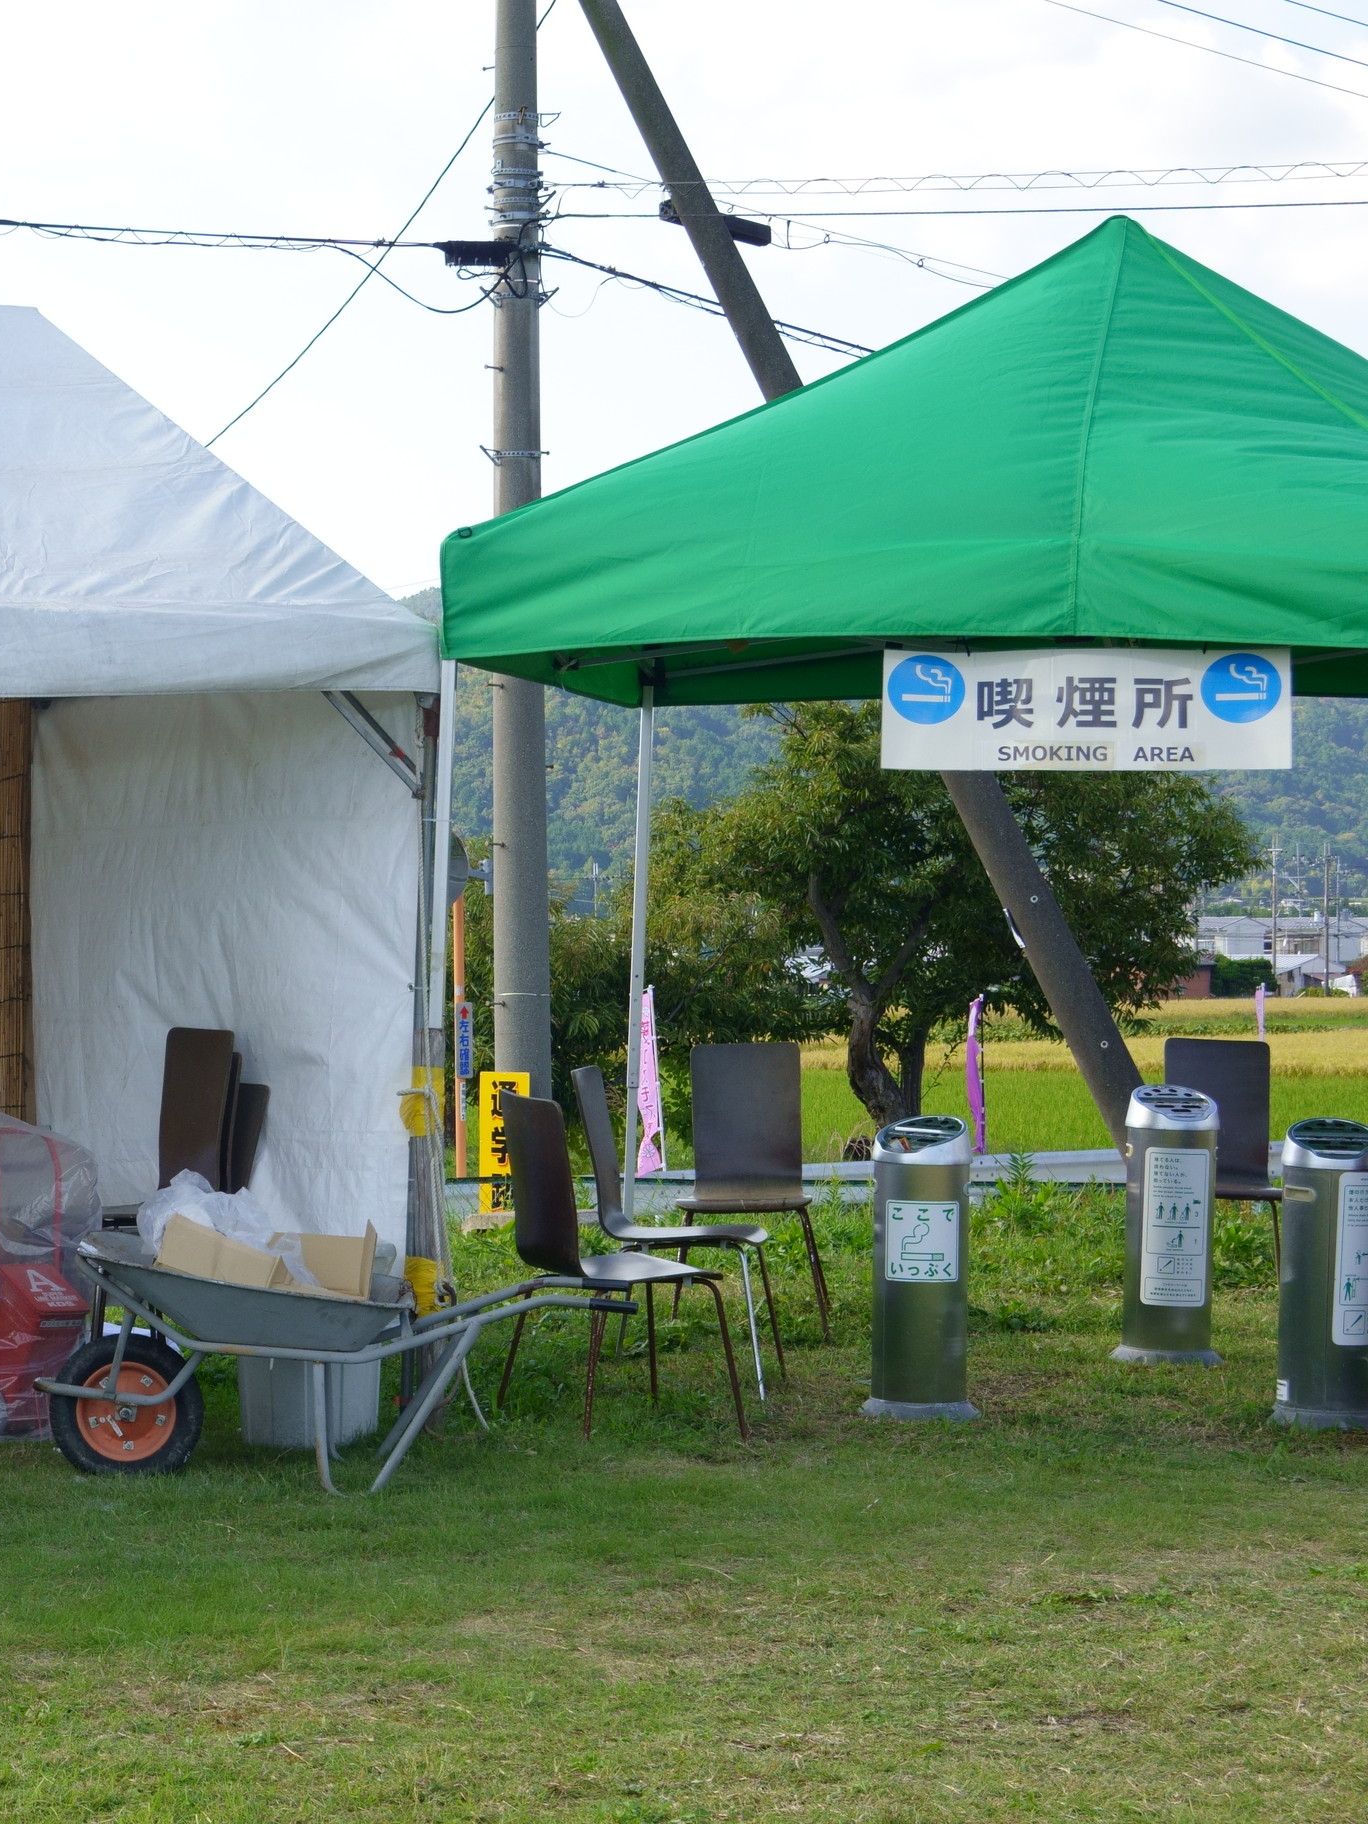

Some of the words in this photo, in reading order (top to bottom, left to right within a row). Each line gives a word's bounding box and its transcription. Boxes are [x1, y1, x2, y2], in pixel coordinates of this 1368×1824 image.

[976, 676, 1194, 730] 喫煙所
[997, 745, 1108, 762] SMOKING
[1132, 746, 1195, 762] AREA
[459, 1020, 470, 1075] 左右確認
[892, 1207, 955, 1222] ここで
[890, 1261, 952, 1277] いっぷく
[25, 1269, 66, 1292] A
